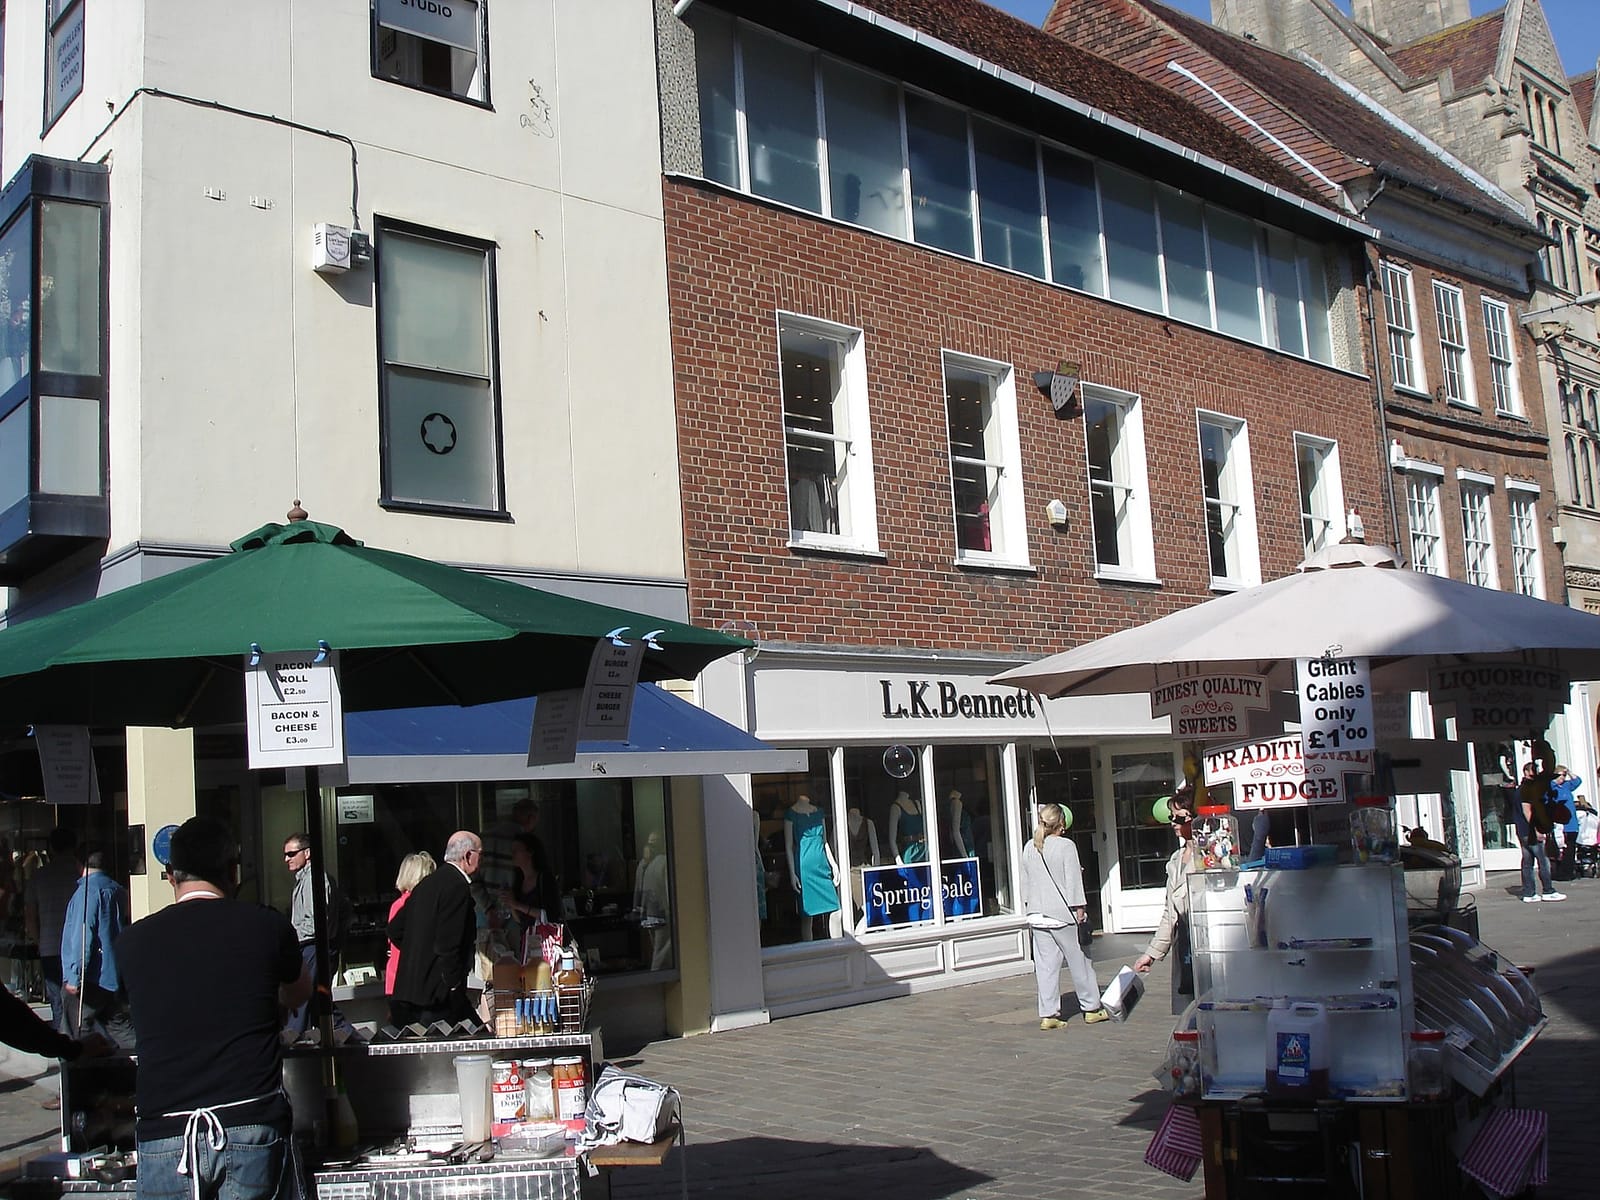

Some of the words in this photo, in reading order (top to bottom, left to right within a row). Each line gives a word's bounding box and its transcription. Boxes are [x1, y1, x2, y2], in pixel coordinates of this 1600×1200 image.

[275, 662, 313, 671] BACON
[1308, 659, 1357, 677] Giant
[280, 675, 308, 683] ROLL
[1438, 668, 1562, 691] LIQUORICE
[284, 687, 306, 695] £2.50
[1155, 680, 1199, 706] FINEST
[1203, 677, 1262, 698] QUALITY
[1306, 681, 1365, 702] Cables
[271, 711, 309, 720] BACON
[312, 710, 320, 718] &
[1315, 706, 1355, 722] Only
[1472, 708, 1535, 726] ROOT
[275, 723, 318, 732] CHEESE
[1178, 716, 1237, 735] SWEETS
[1207, 740, 1369, 774] TRADITIAL
[1242, 778, 1339, 803] FUDGE
[872, 880, 931, 915] Spring
[942, 873, 973, 901] Sale
